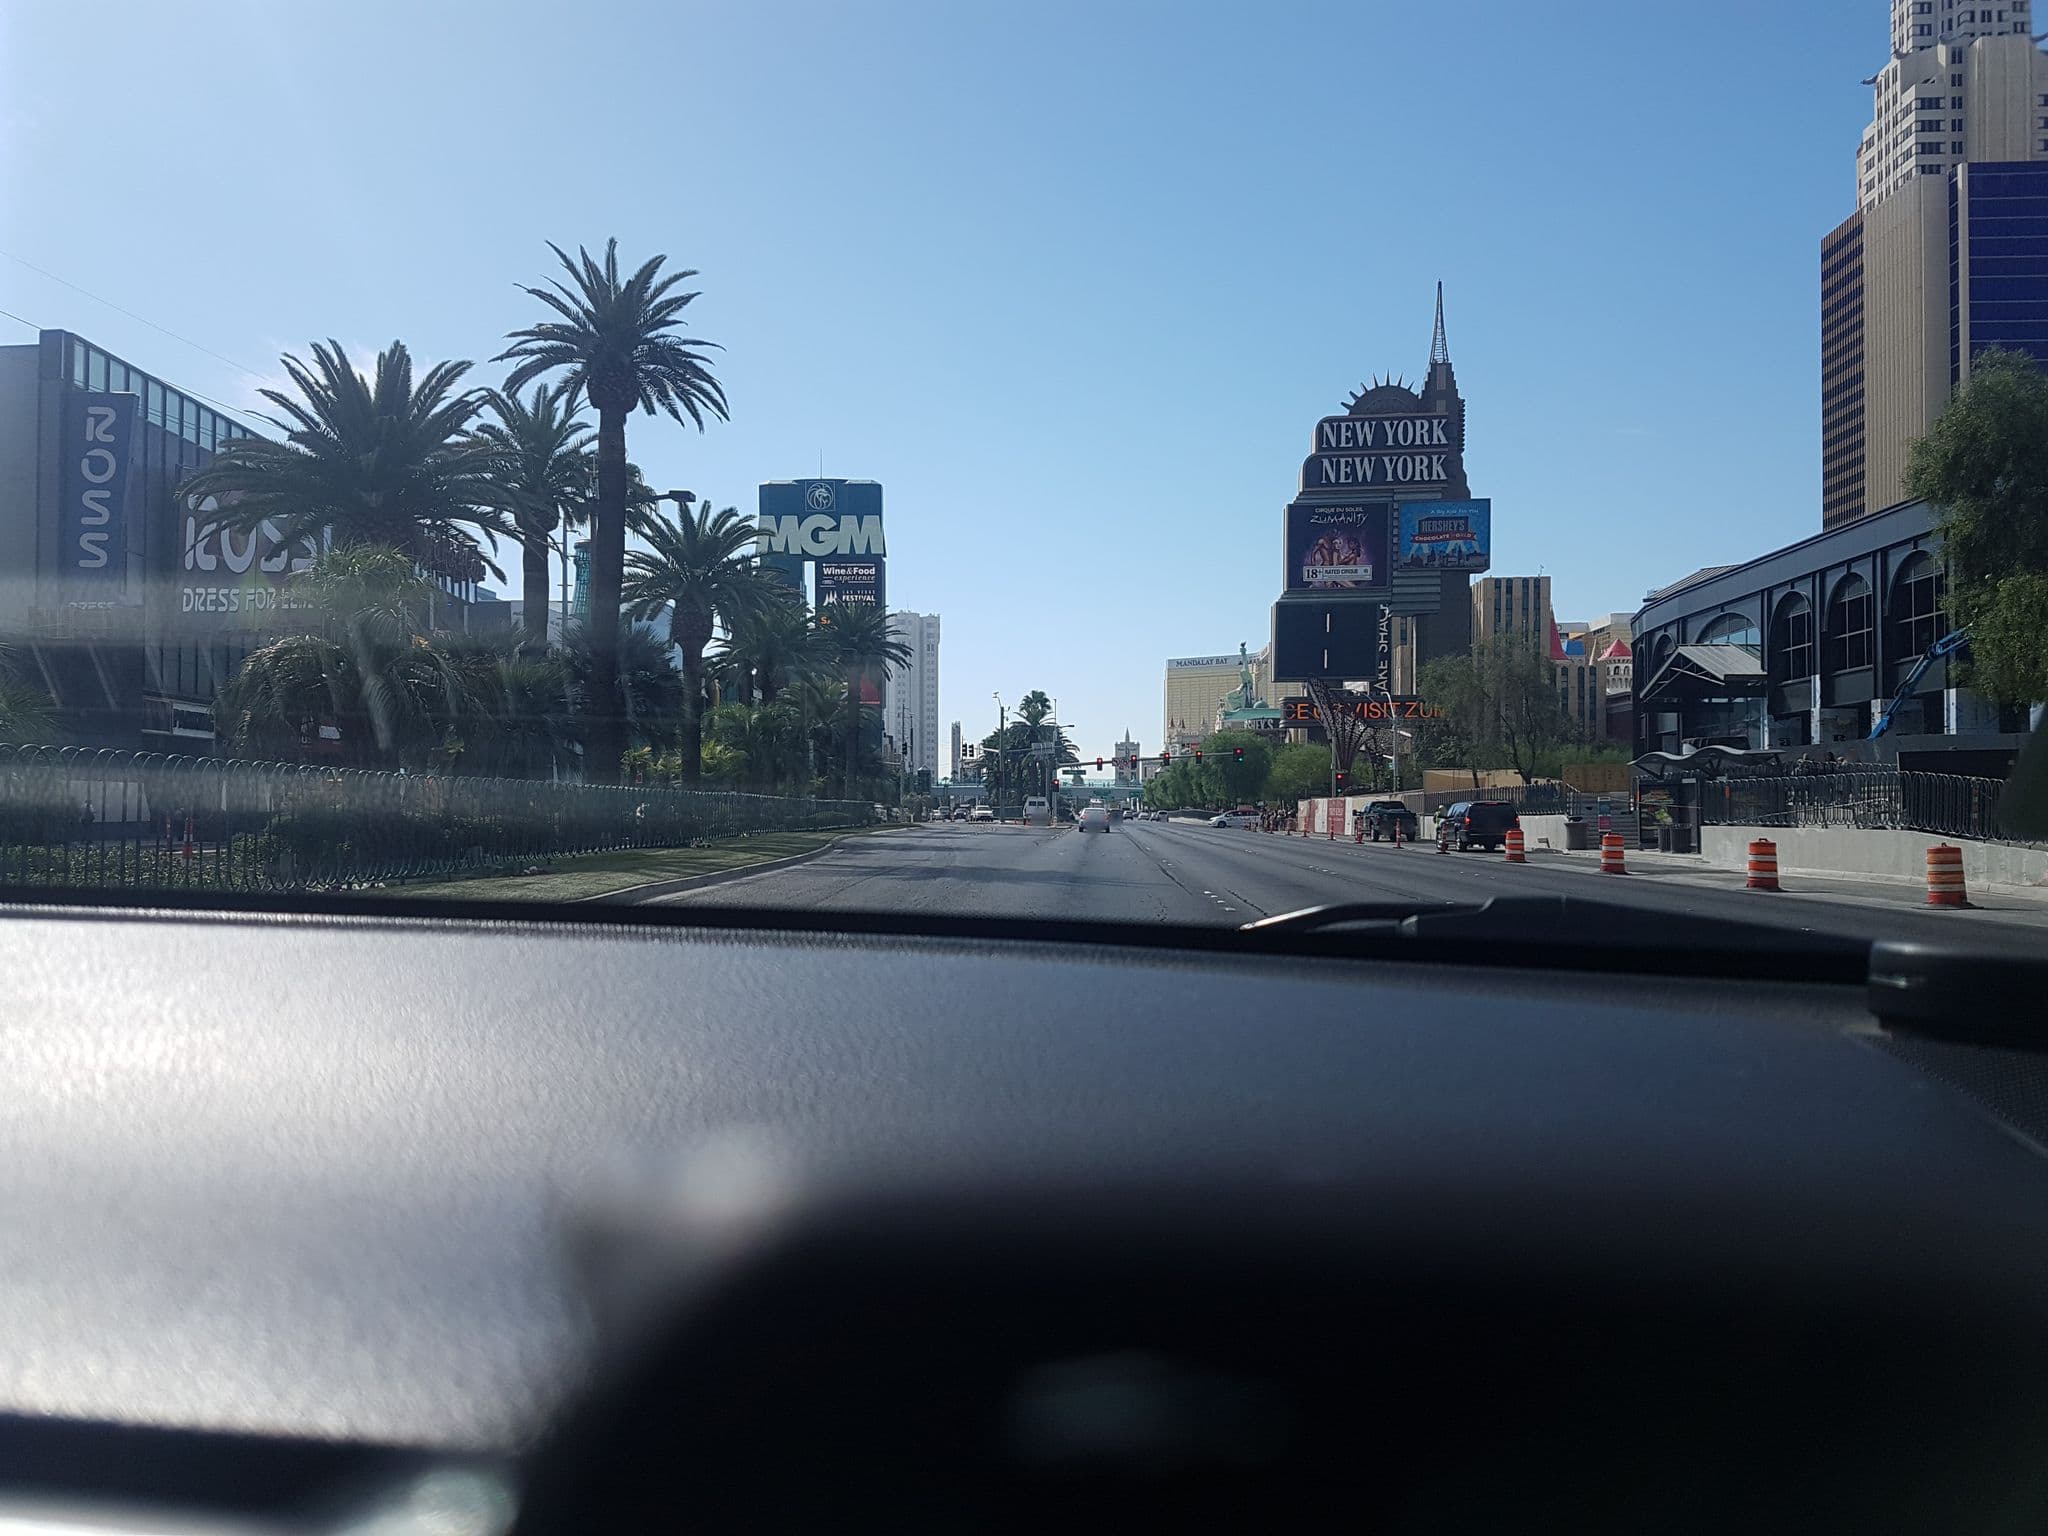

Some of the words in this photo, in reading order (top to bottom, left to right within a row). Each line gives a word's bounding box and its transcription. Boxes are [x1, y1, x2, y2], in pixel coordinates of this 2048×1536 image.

[1321, 420, 1377, 448] NEW
[1382, 418, 1449, 446] YORK
[1320, 456, 1377, 484] NEW
[1381, 454, 1448, 482] YORK
[78, 406, 117, 568] ROSS
[1310, 511, 1368, 528] ZUMANITY
[1422, 520, 1465, 532] HERSHEY'S
[756, 513, 885, 557] MGM
[1414, 533, 1449, 541] CHOCOLATE
[833, 575, 876, 583] experience
[182, 587, 240, 613] DRESS
[245, 587, 277, 610] FOR
[842, 594, 876, 602] FESTIVAL
[1175, 659, 1214, 668] MANDALAY
